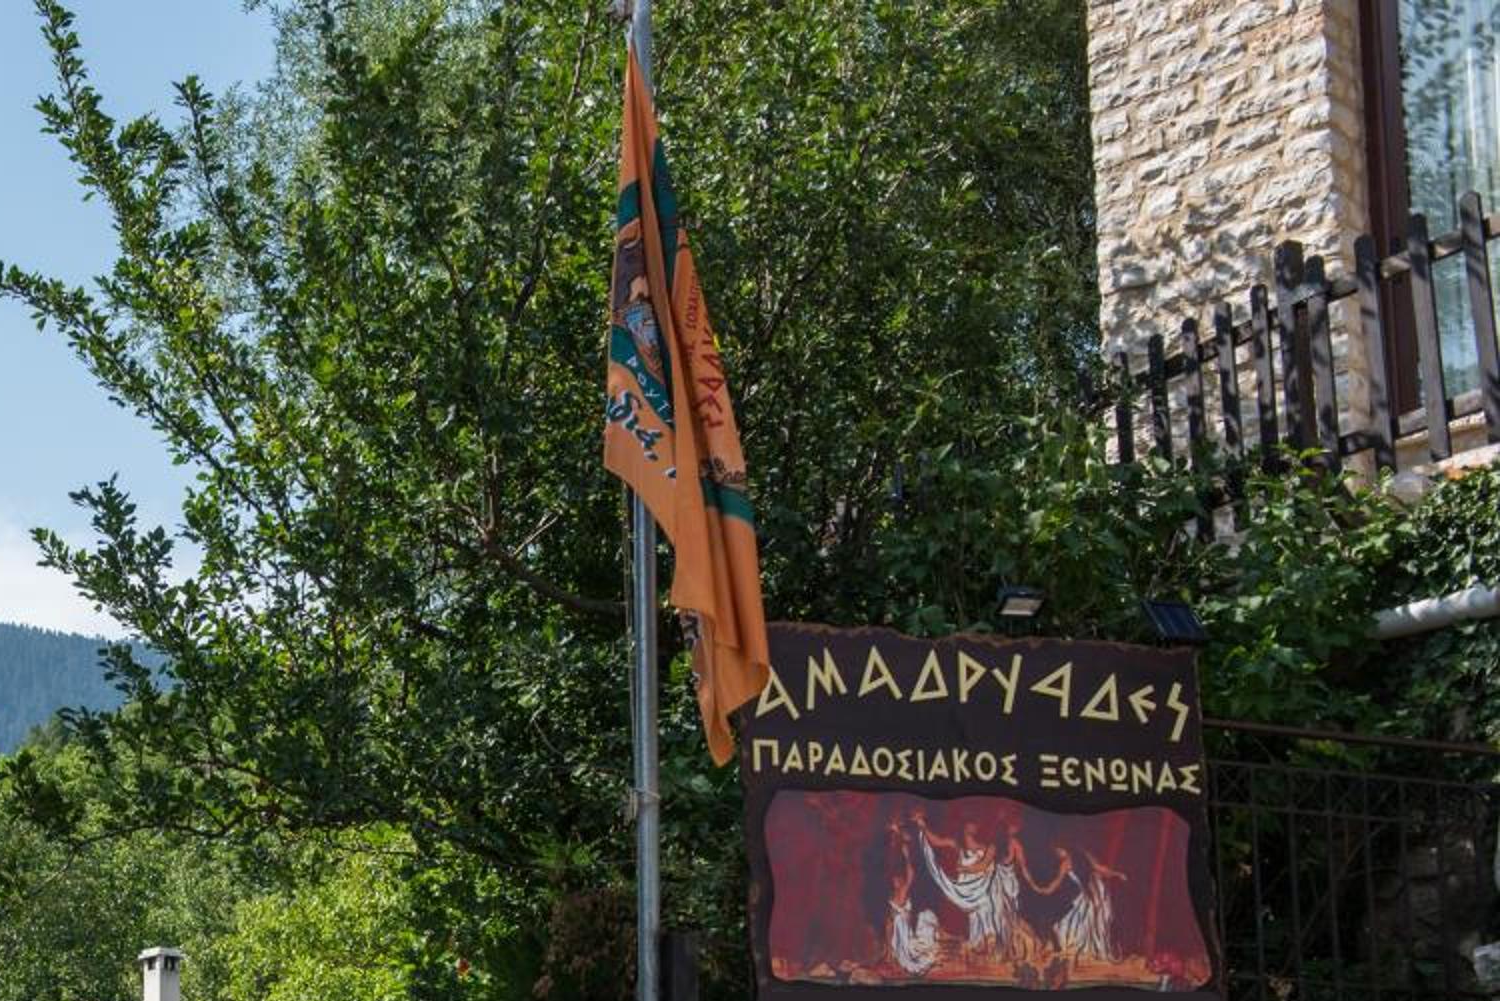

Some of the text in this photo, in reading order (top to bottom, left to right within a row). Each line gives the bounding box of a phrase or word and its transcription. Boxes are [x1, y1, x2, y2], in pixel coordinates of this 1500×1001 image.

[756, 645, 1189, 742] ΑΜΑΔΡΥΑΔΕΣ
[752, 738, 1201, 795] ΠΑΡΑΔΟΣΙΑΚΟΣ ΞΕΝΩΝΑΣ
